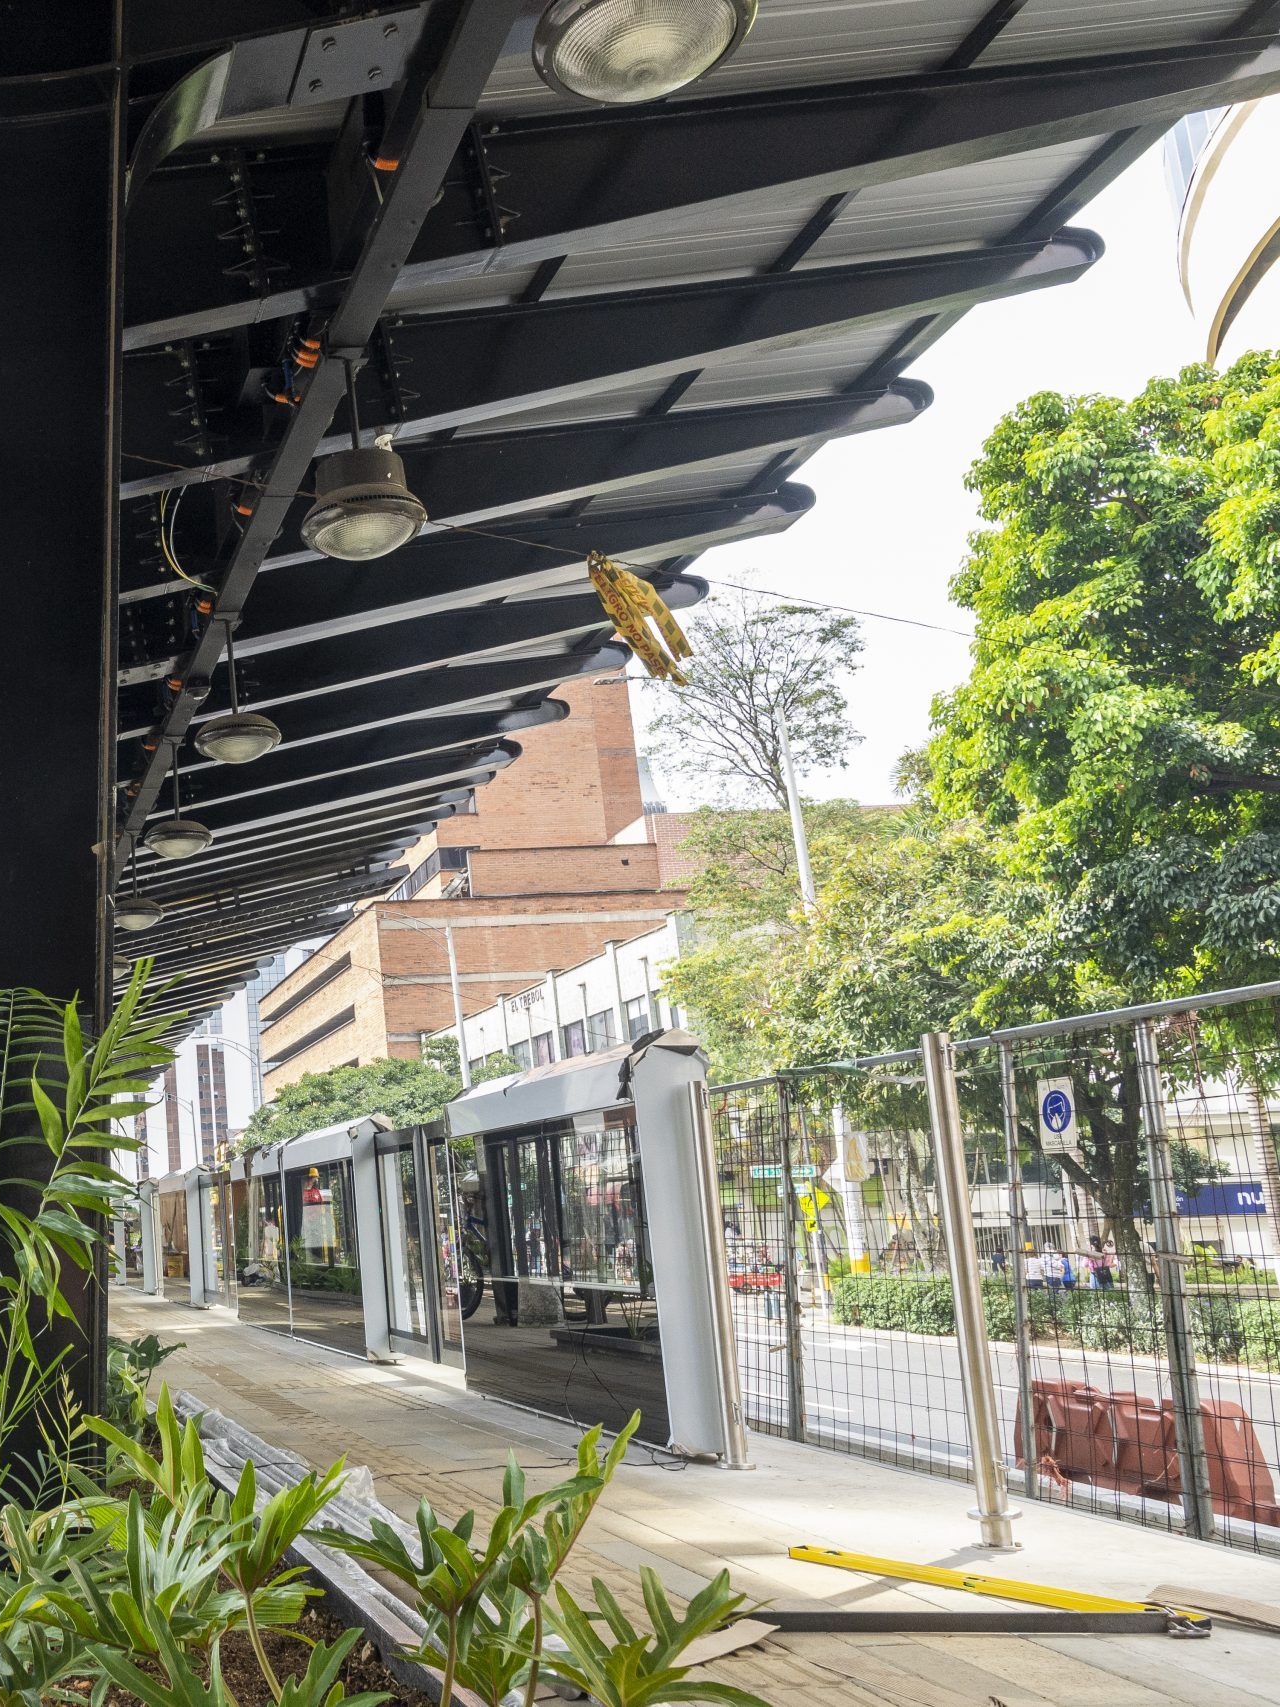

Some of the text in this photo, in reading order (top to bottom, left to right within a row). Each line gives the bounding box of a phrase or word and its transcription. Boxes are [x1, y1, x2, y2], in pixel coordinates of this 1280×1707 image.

[626, 624, 642, 641] NO
[511, 988, 544, 1013] EL TREBOL
